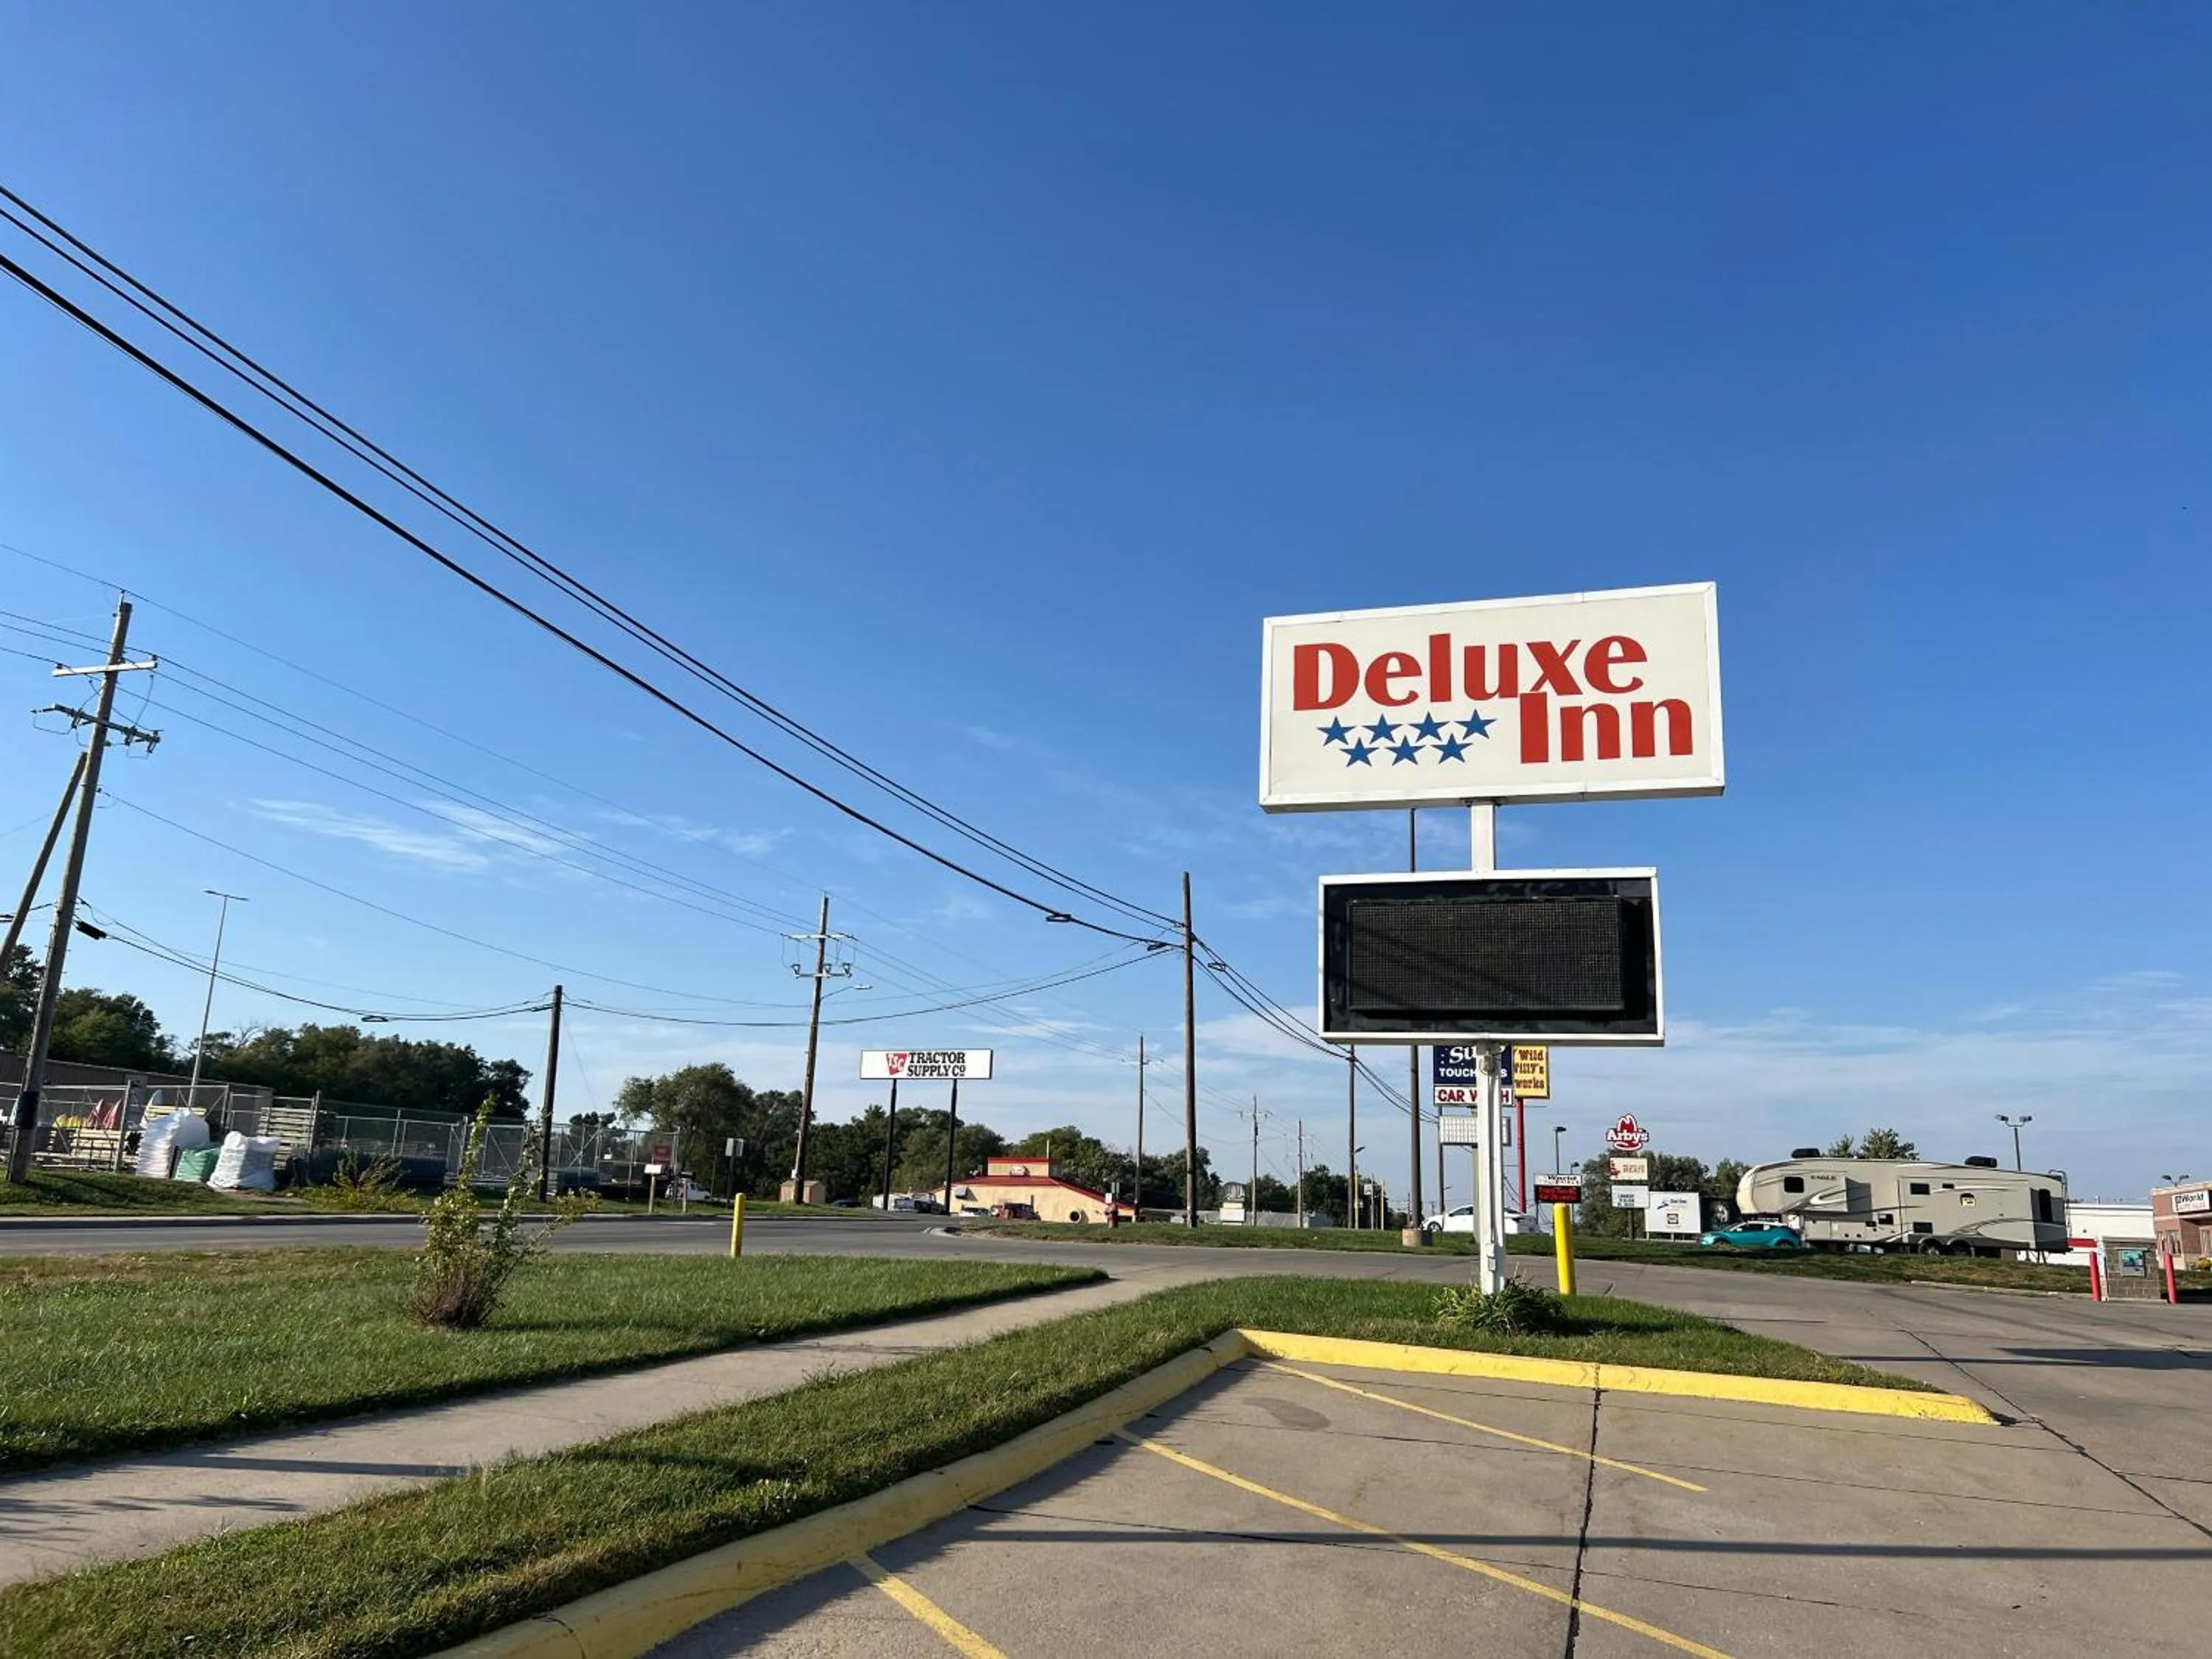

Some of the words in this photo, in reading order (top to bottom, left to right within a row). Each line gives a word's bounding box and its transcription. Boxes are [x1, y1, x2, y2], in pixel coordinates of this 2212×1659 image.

[1293, 632, 1649, 712] Deluxe
[1519, 691, 1694, 765] Inn
[908, 1051, 966, 1064] TRACTOR
[1518, 1049, 1544, 1061] Wild
[907, 1064, 951, 1077] SUPPLY
[1438, 1089, 1465, 1102] CAR
[1607, 1128, 1649, 1144] Arby's
